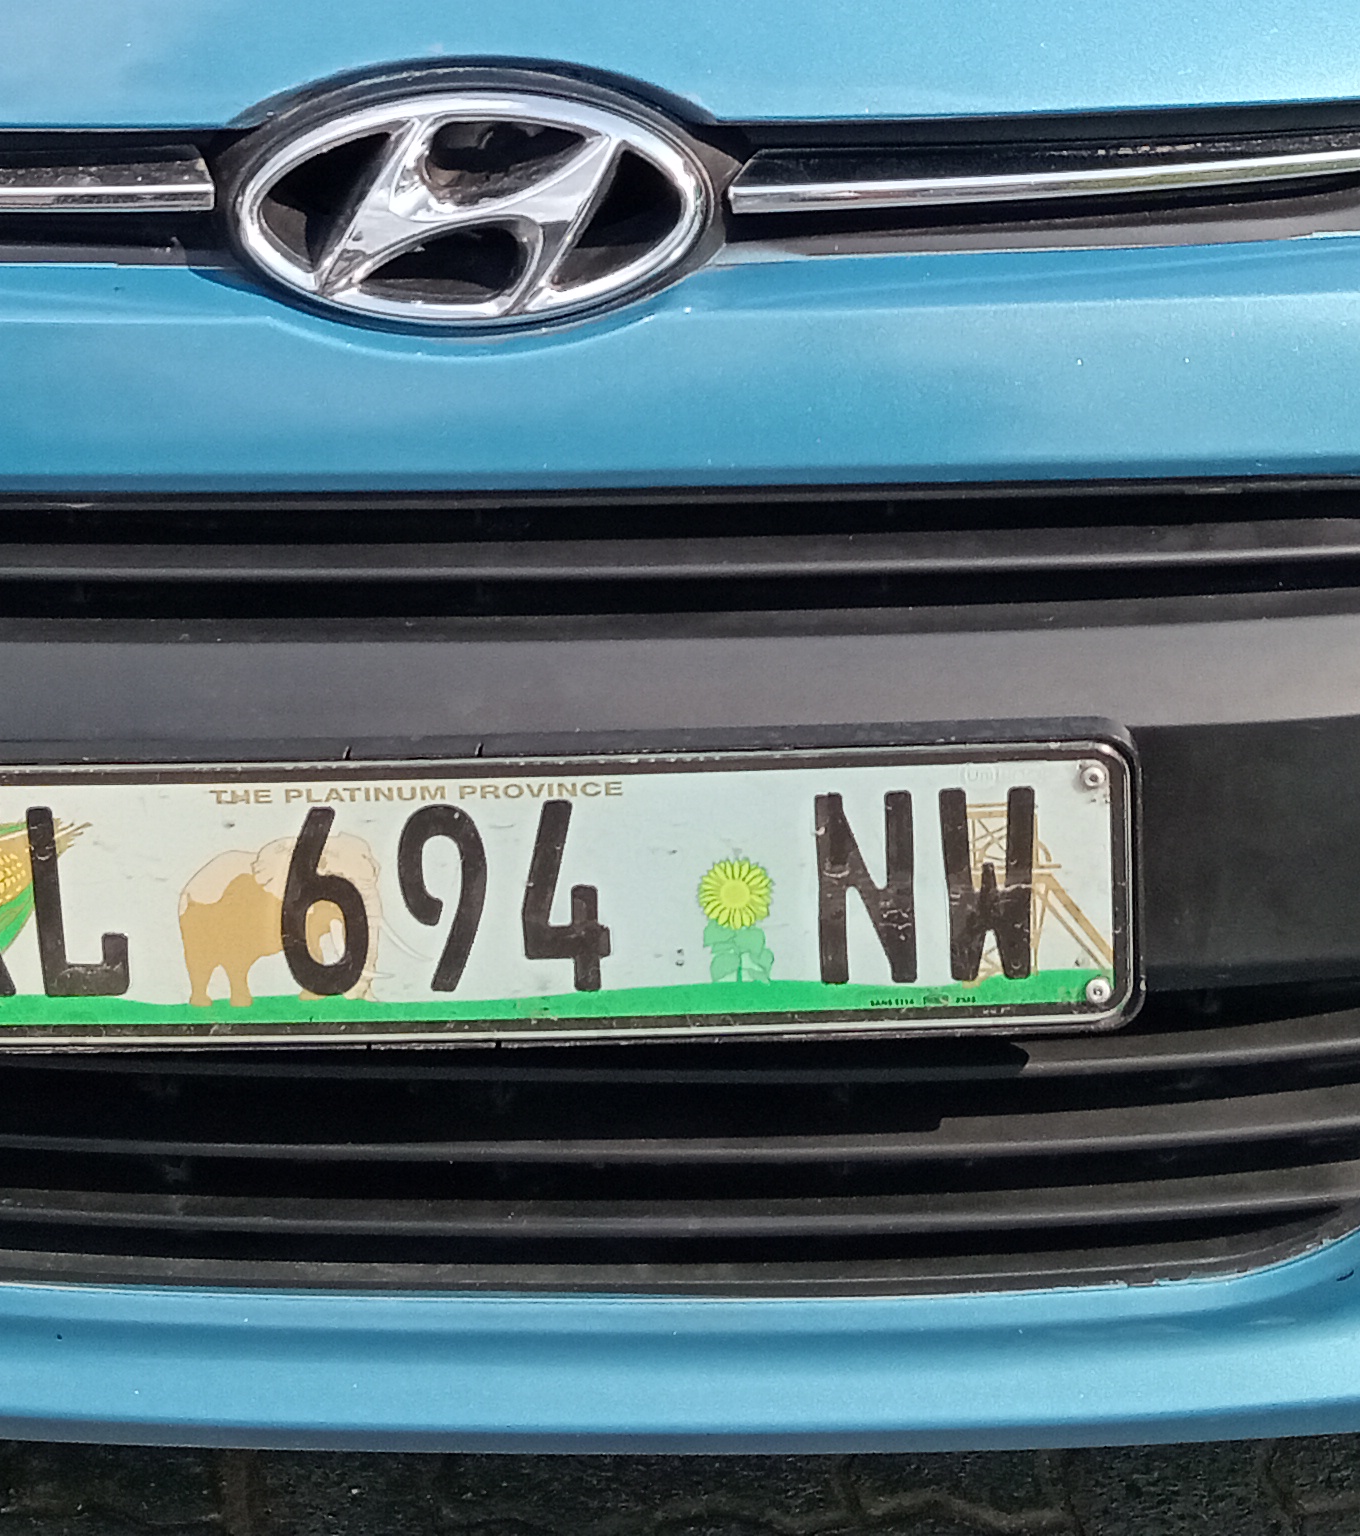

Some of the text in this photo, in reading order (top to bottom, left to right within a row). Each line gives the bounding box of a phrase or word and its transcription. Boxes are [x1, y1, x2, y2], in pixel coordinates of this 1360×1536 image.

[209, 780, 624, 804] THE PLATINUM PROVINCE
[280, 799, 612, 996] 694
[814, 786, 1035, 985] NW
